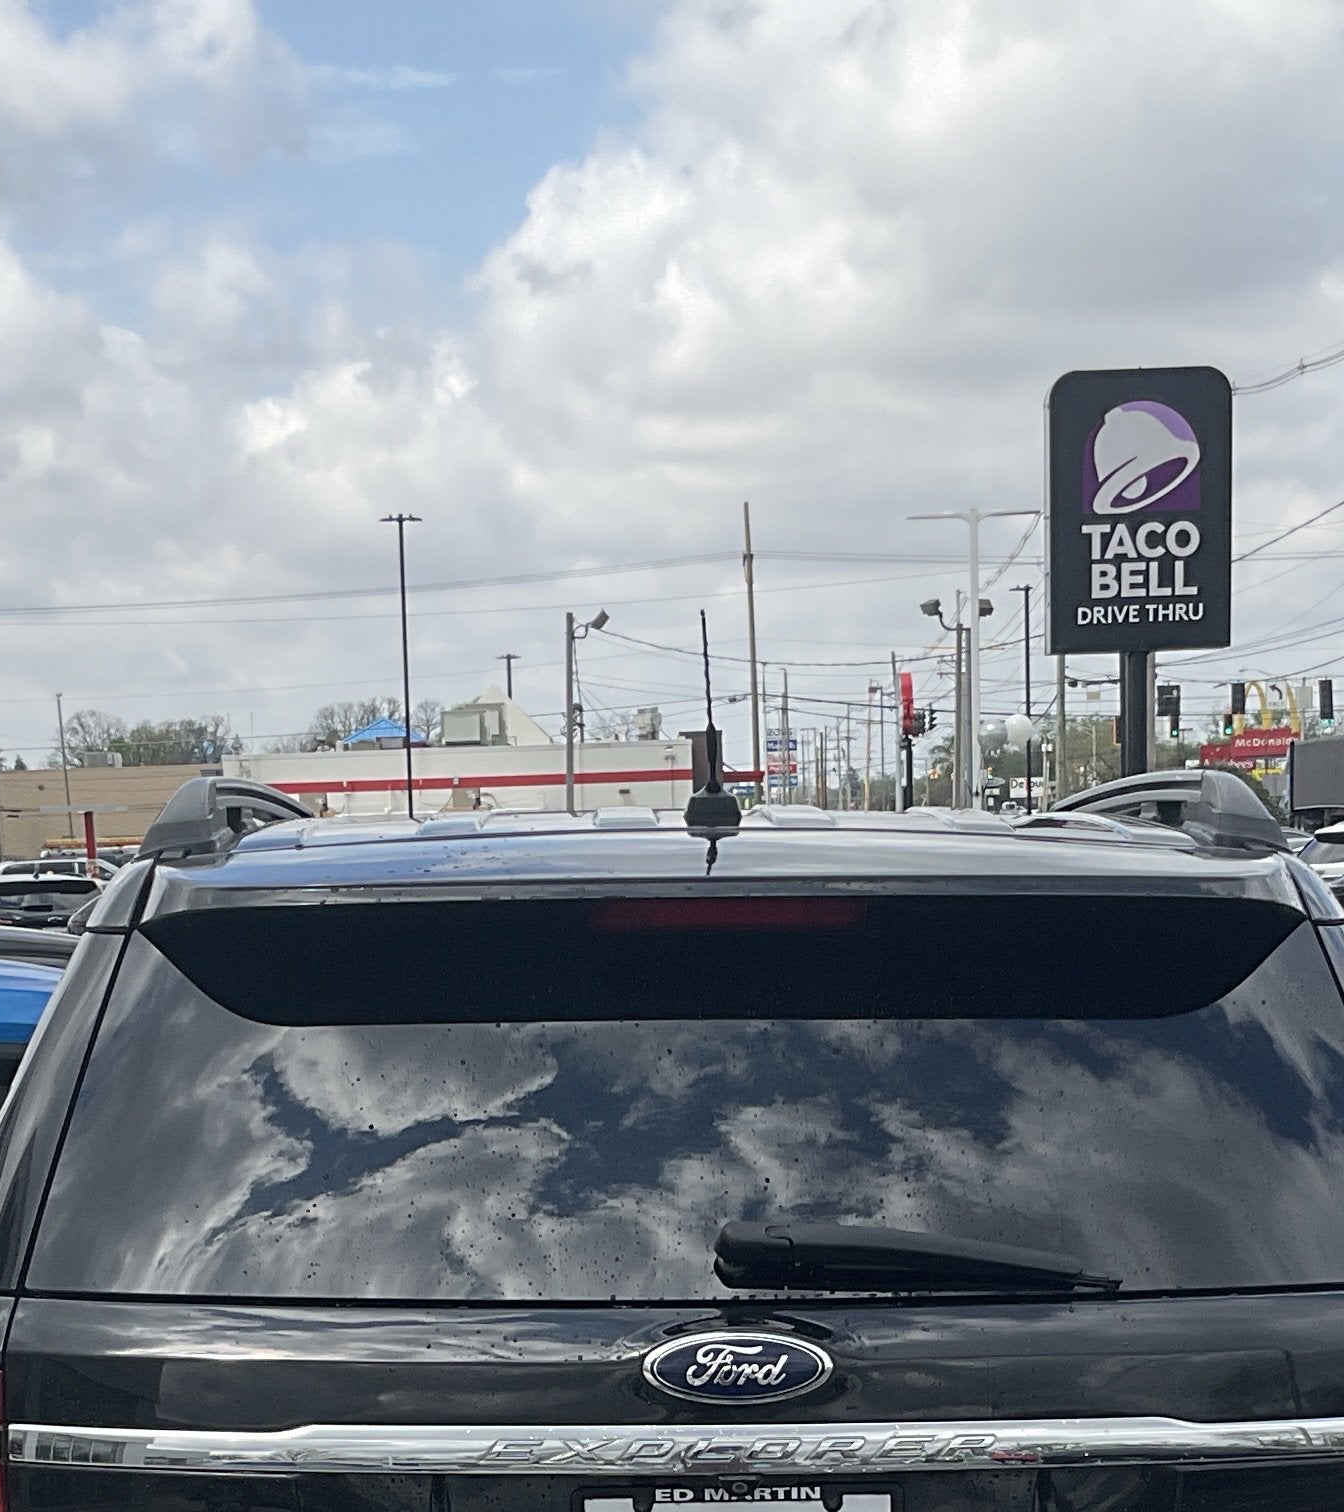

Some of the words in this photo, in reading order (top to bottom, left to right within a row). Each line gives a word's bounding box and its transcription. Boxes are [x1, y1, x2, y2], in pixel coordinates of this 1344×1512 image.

[1081, 520, 1201, 560] TACO
[1090, 560, 1199, 599] BELL
[1077, 604, 1141, 625] DRIVE
[1145, 602, 1204, 622] THRU
[685, 1343, 789, 1387] Ford
[478, 1433, 999, 1466] EXPLORER
[655, 1488, 695, 1502] ED
[704, 1486, 821, 1501] MRTIN
